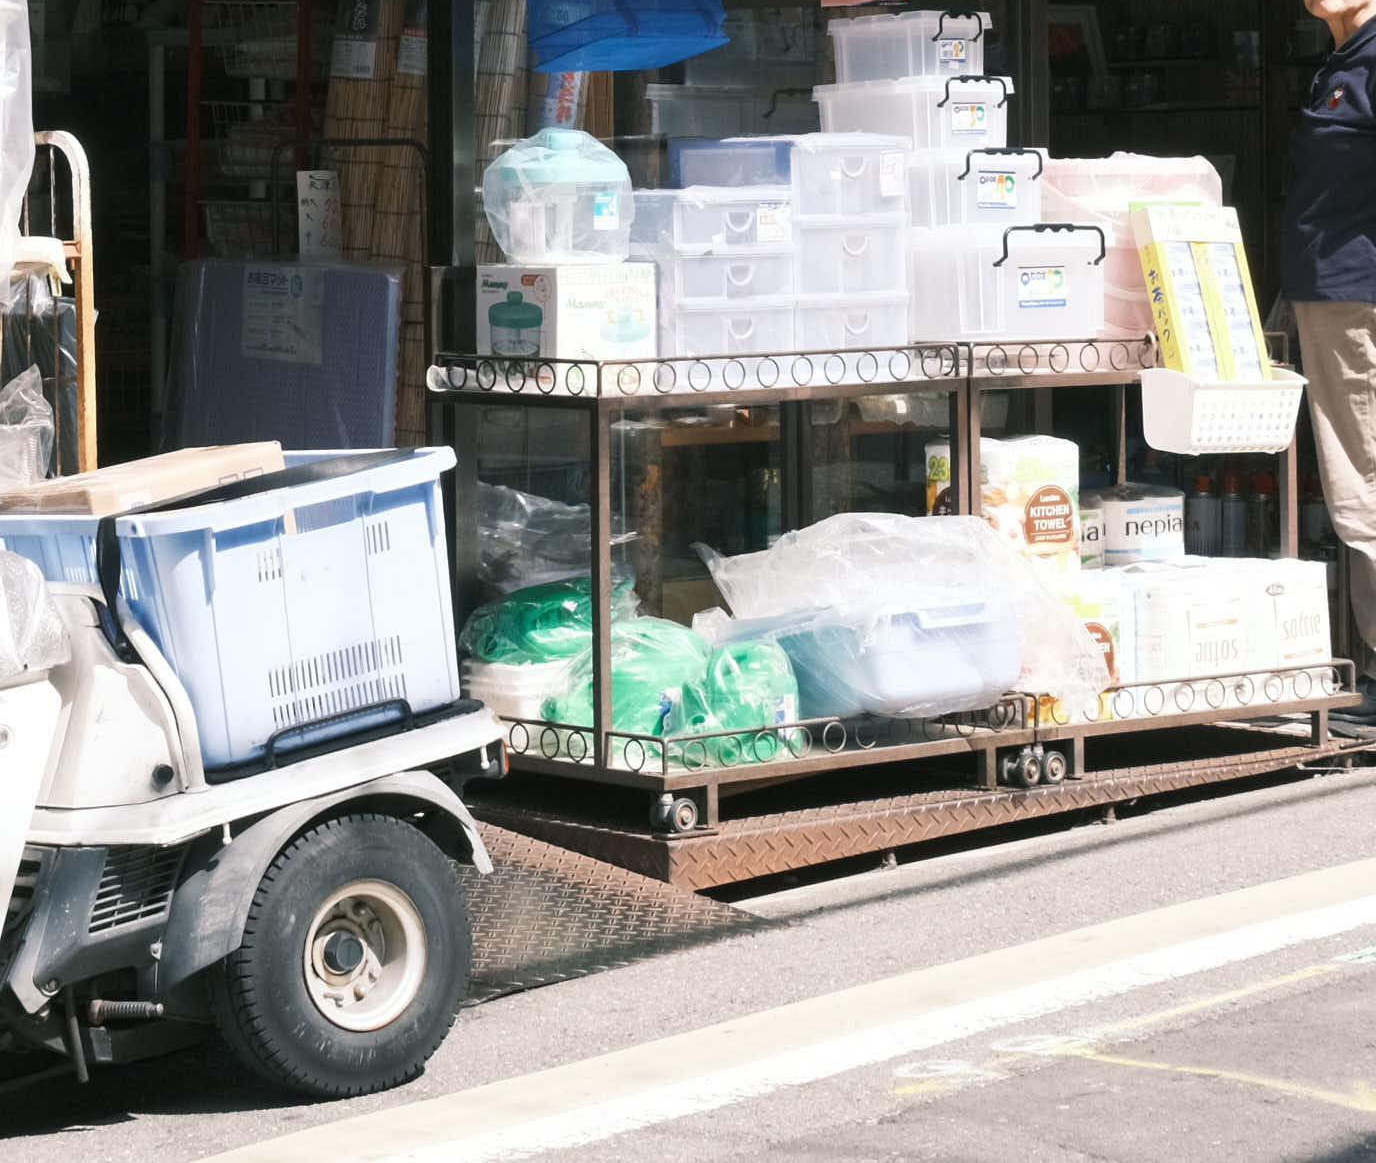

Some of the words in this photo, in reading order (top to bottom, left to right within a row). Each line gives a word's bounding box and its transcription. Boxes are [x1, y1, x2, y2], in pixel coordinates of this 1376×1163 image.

[1029, 503, 1070, 518] KITCHEN
[1033, 517, 1068, 532] TOWEL
[1125, 514, 1183, 538] nepia
